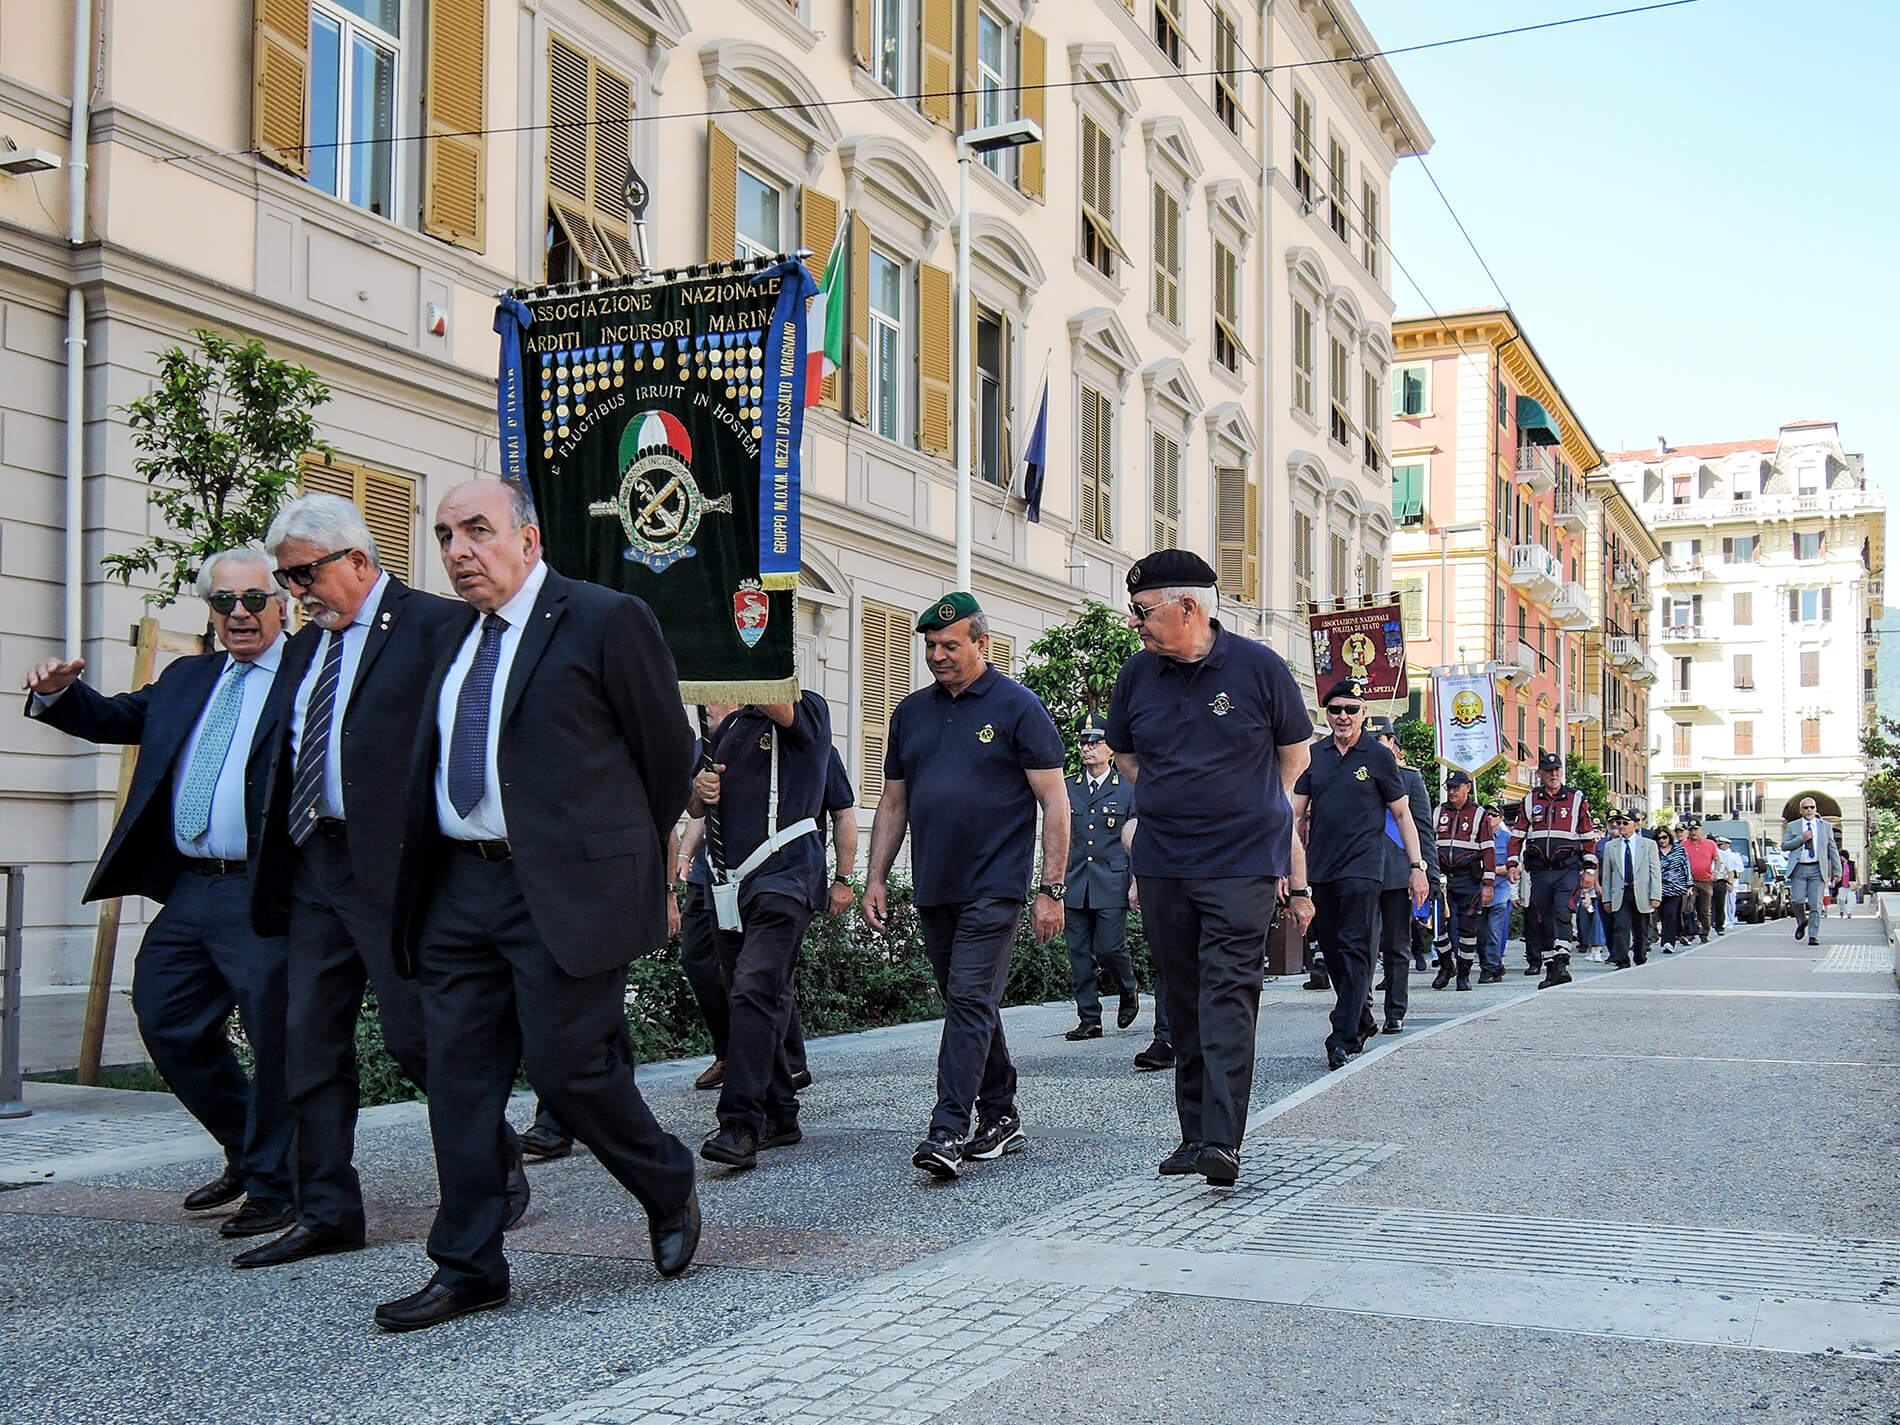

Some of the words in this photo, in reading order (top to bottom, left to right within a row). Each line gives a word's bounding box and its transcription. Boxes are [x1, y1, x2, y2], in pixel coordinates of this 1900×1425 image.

[680, 277, 781, 306] NAZIONALE
[526, 331, 581, 354] ARDITI
[601, 318, 691, 344] INCURSORI
[708, 306, 776, 333] MARINA
[780, 321, 797, 377] VARIGNANO
[558, 393, 626, 458] FLUCTIBUS
[636, 384, 685, 400] IRRUIT
[693, 392, 710, 407] IN
[713, 403, 760, 459] HOSTEM
[774, 382, 793, 435] D'ASSALTO
[507, 436, 521, 482] ARINAI
[774, 438, 790, 468] MEZZI
[774, 472, 789, 511] M.O.V.M.
[773, 514, 788, 554] GRUPPO
[1321, 616, 1359, 628] ASSOCIAZIONE
[1359, 613, 1390, 623] NAZIONALE
[1332, 625, 1354, 634] POLIZIA
[1355, 624, 1361, 632] DI
[1362, 622, 1380, 631] STATO
[1373, 685, 1396, 694] SPEZIA
